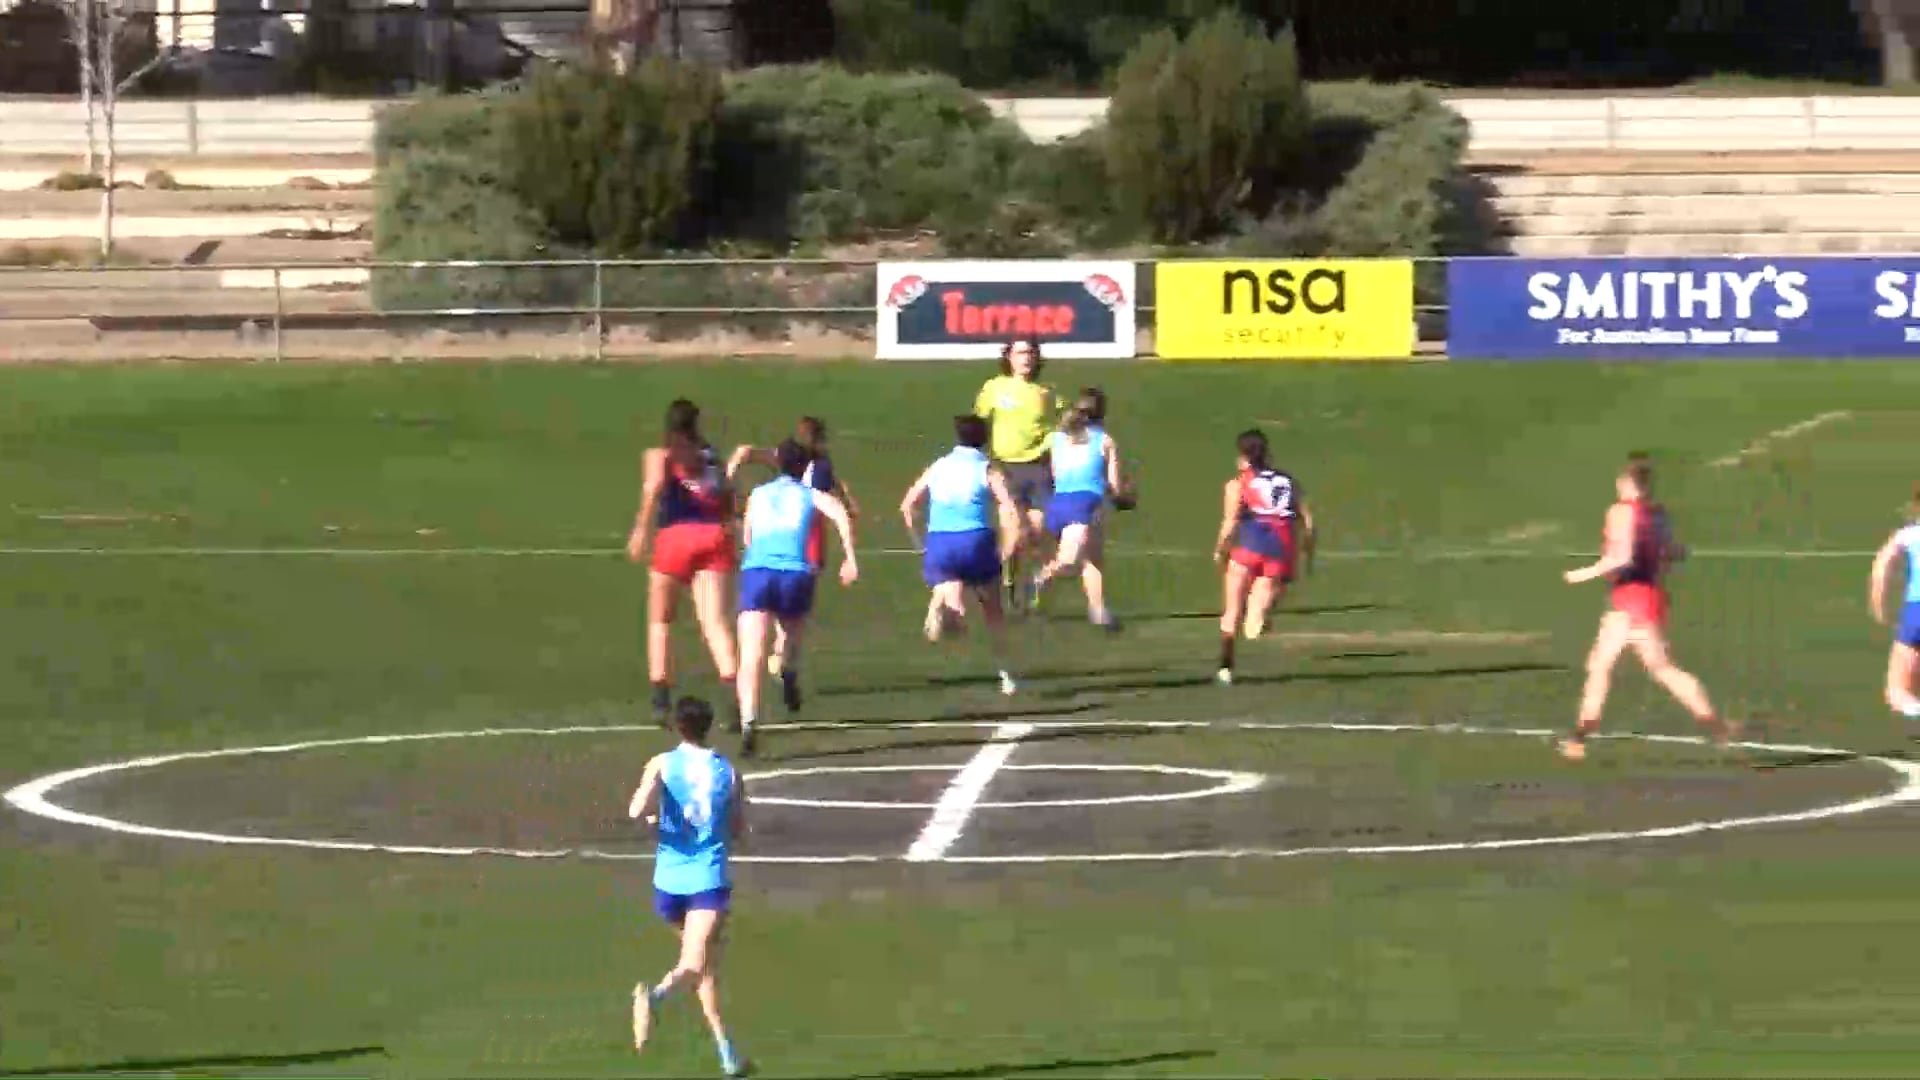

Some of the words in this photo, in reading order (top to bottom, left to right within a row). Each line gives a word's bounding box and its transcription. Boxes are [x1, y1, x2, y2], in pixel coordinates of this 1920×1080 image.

[941, 289, 1075, 334] Terrace
[1223, 269, 1345, 314] nsa
[1527, 265, 1809, 319] SMITHY'S
[1874, 269, 1920, 318] S
[1223, 324, 1346, 349] secury
